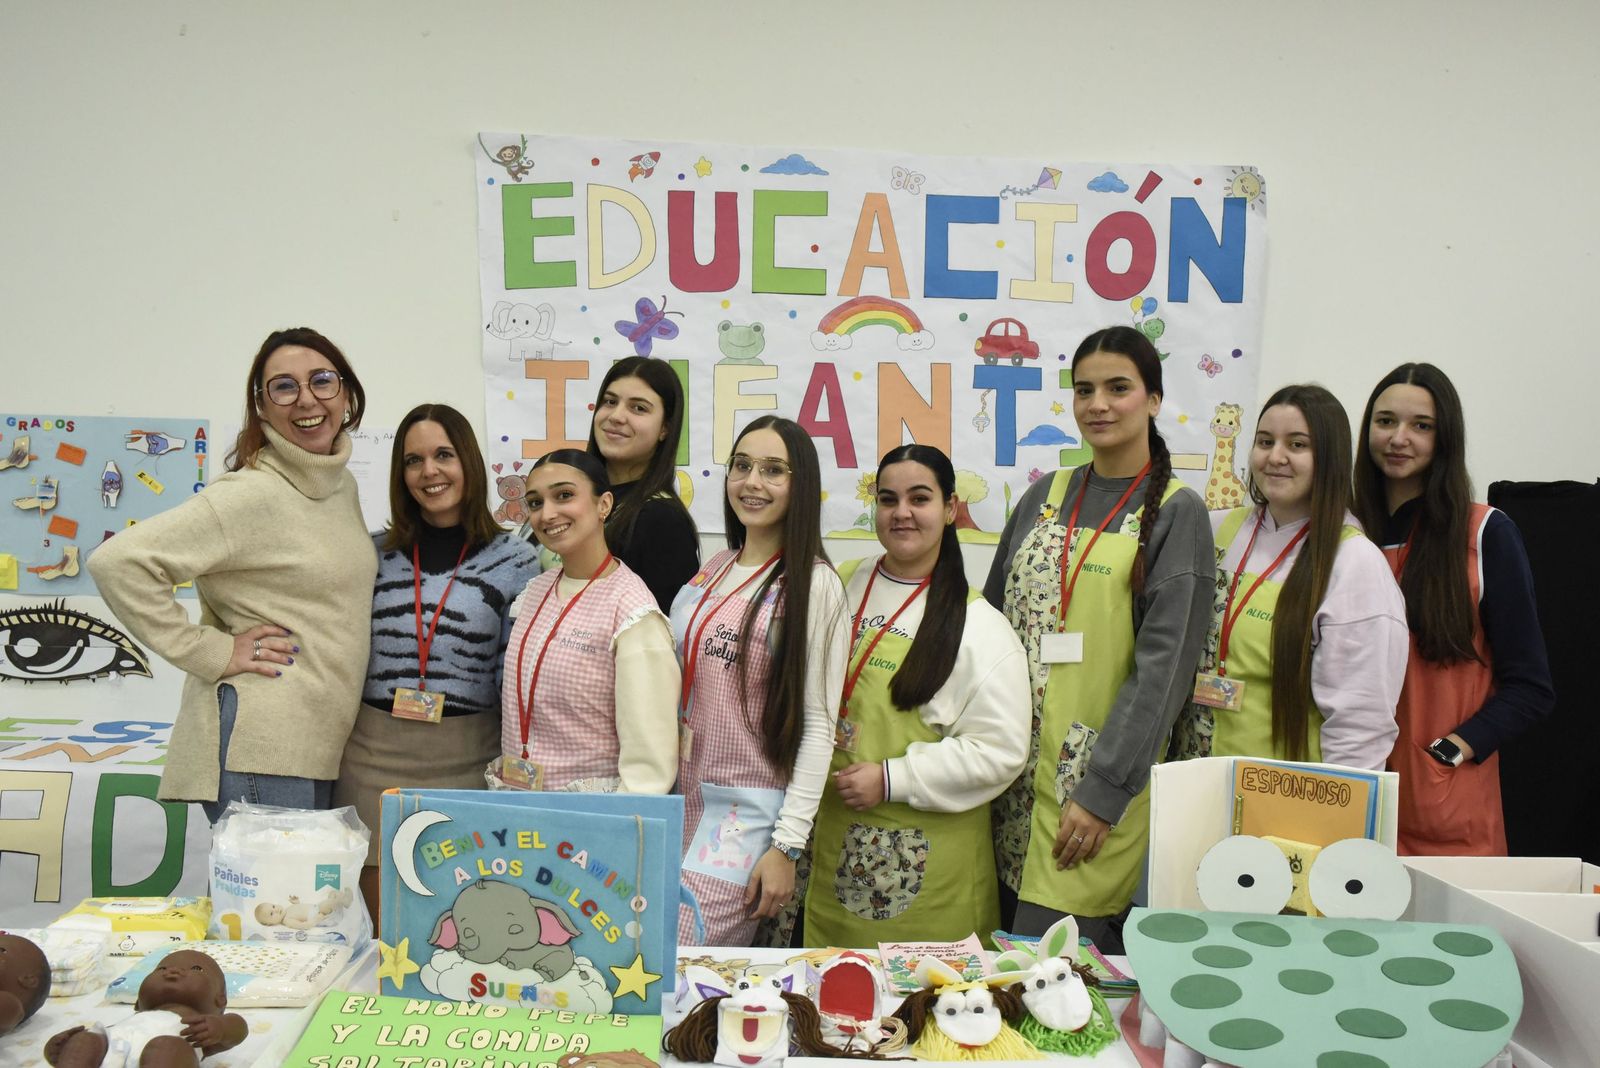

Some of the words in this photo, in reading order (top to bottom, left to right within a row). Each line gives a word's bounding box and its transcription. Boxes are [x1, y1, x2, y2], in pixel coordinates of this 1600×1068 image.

[502, 170, 1247, 304] EDUCACIÓN
[6, 417, 75, 432] GRADOS
[521, 359, 1208, 470] IFANT
[43, 539, 50, 547] 3
[1082, 563, 1112, 575] NIEVES
[714, 623, 739, 642] Seño
[868, 656, 897, 672] LUCIA
[1241, 767, 1351, 807] ESPONJOSO
[420, 831, 485, 869] BENI
[491, 828, 508, 847] Y
[517, 831, 547, 849] EL
[214, 866, 259, 887] Pañales
[454, 866, 472, 886] A
[477, 857, 524, 877] LOS
[535, 866, 622, 944] DULCES
[221, 913, 242, 941] 1
[340, 995, 382, 1016] EL
[402, 999, 508, 1019] MONO
[528, 1007, 629, 1028] PEPE
[331, 1024, 362, 1045] Y
[376, 1023, 431, 1047] LA
